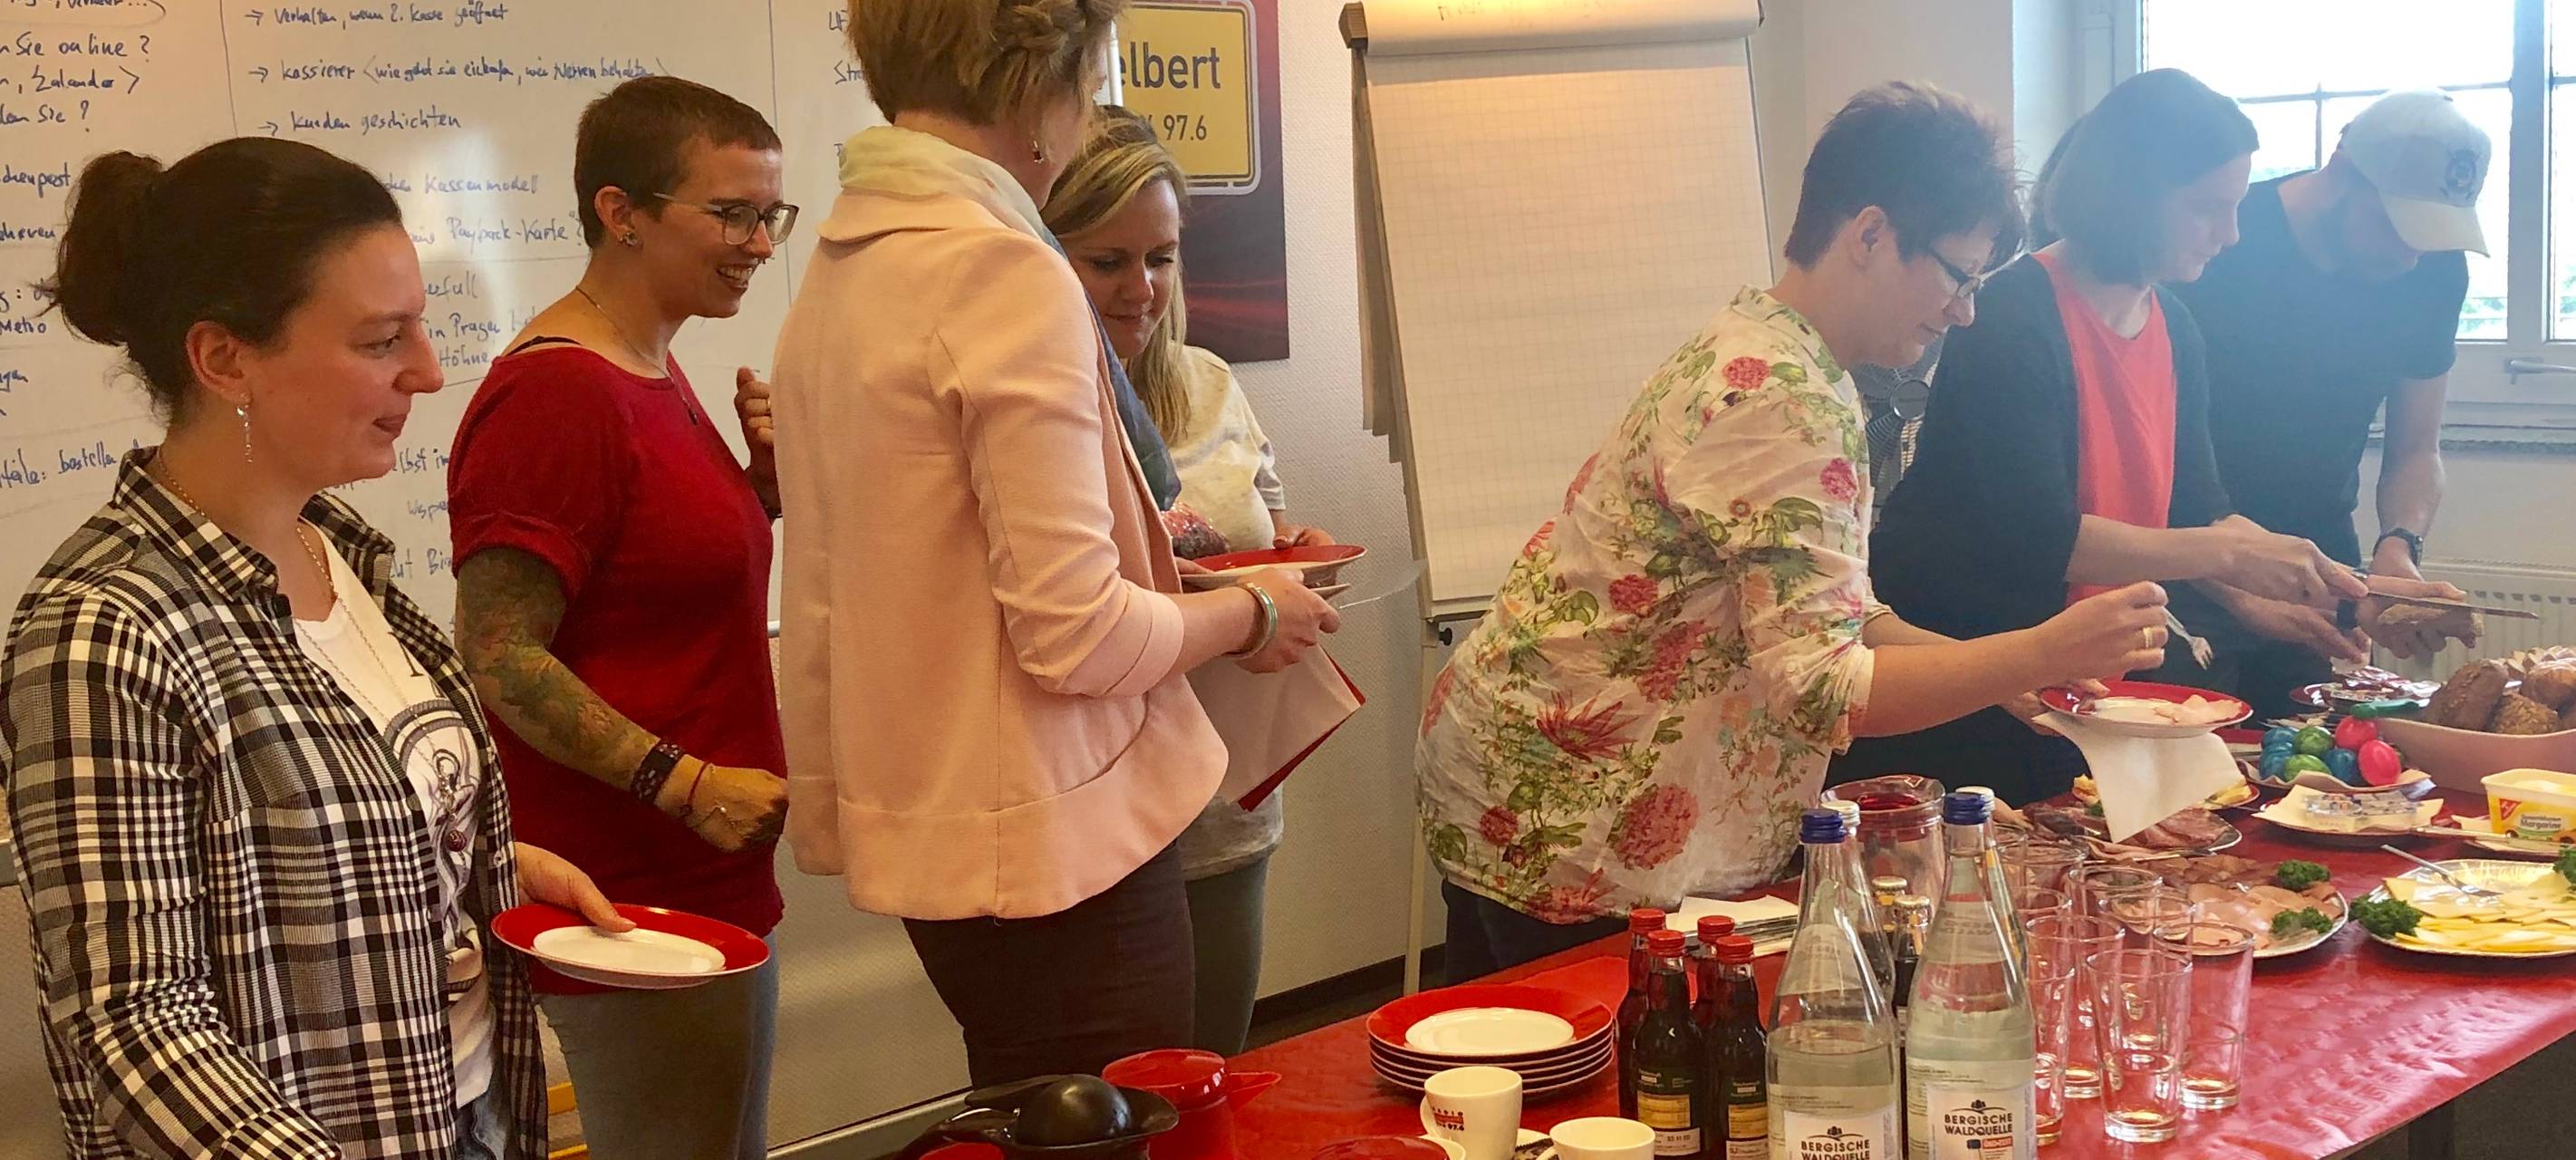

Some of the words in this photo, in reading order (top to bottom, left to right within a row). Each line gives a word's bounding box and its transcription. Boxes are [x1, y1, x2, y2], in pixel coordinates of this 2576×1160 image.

[15, 31, 44, 56] Sie
[37, 103, 66, 123] Sie
[1163, 114, 1208, 141] 97.6
[1944, 1112, 2013, 1126] BERGISCHE
[1944, 1123, 2013, 1136] WALDQUELLE
[1800, 1138, 1871, 1153] BERGISCHE
[1800, 1150, 1871, 1160] WALDQUELLE
